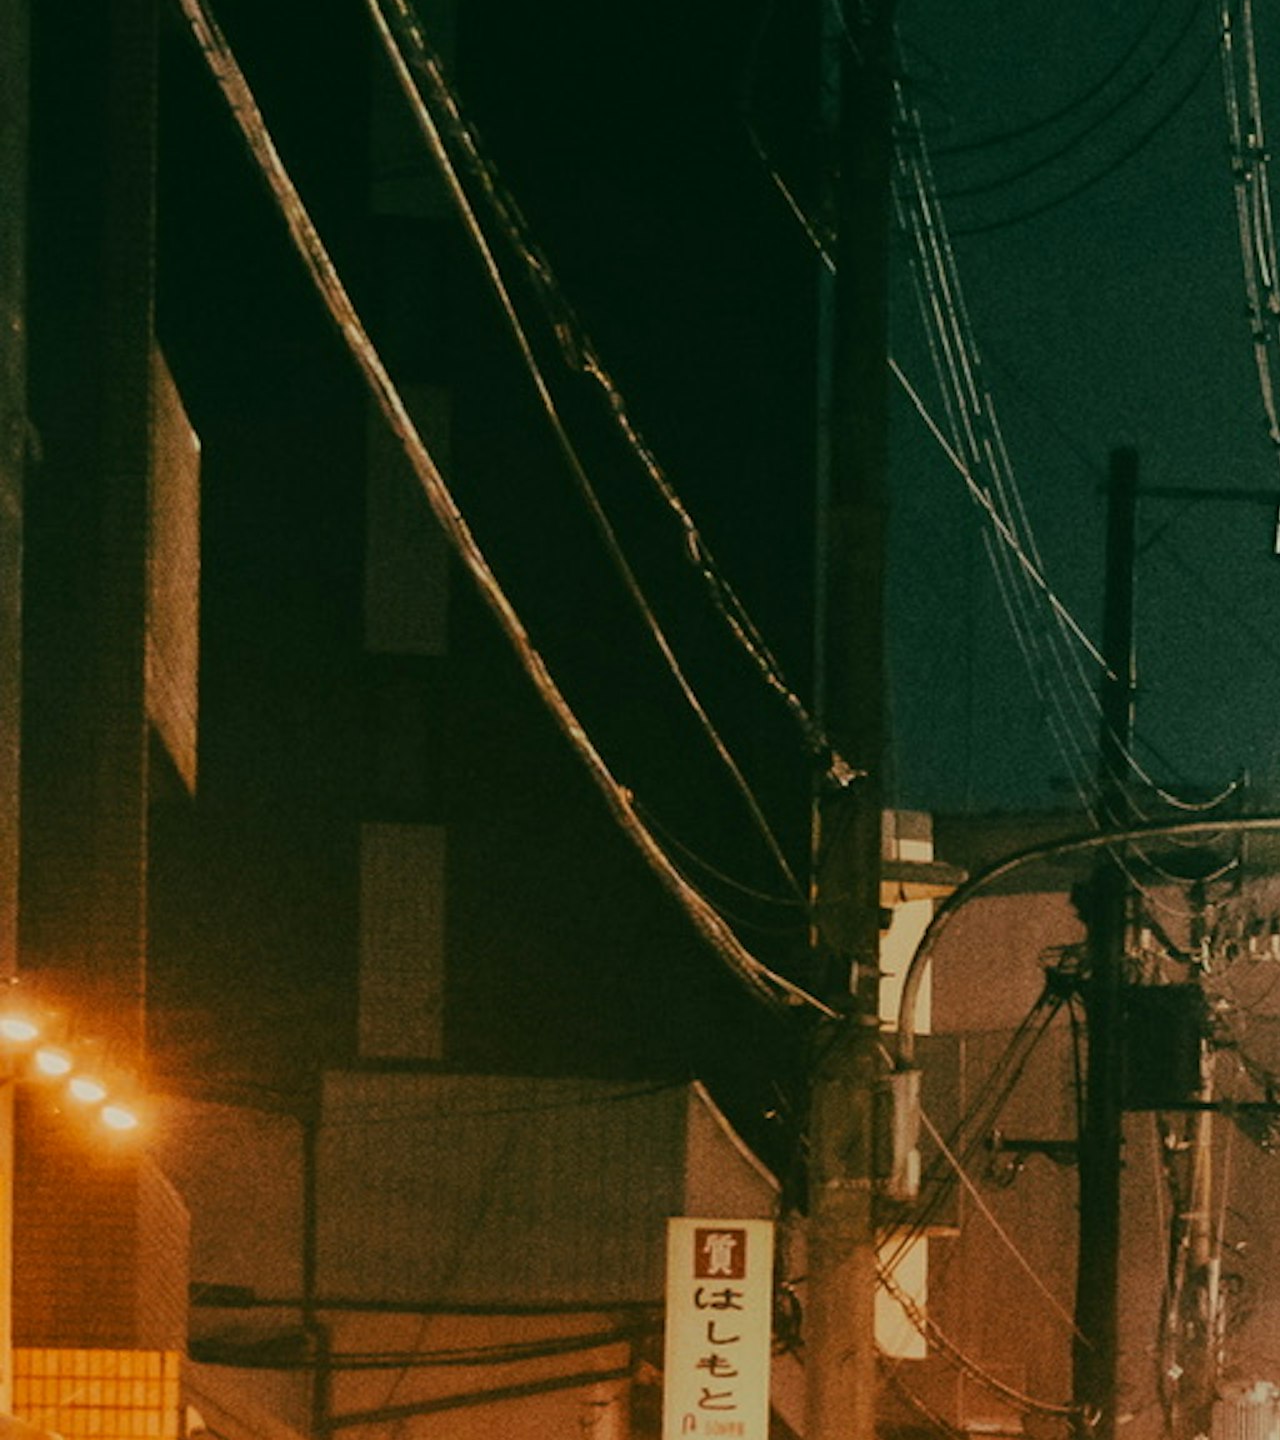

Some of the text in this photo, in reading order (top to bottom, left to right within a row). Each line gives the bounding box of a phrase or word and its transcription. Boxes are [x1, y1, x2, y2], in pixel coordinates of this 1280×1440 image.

[703, 1232, 738, 1277] 質
[694, 1286, 744, 1412] はしもと
